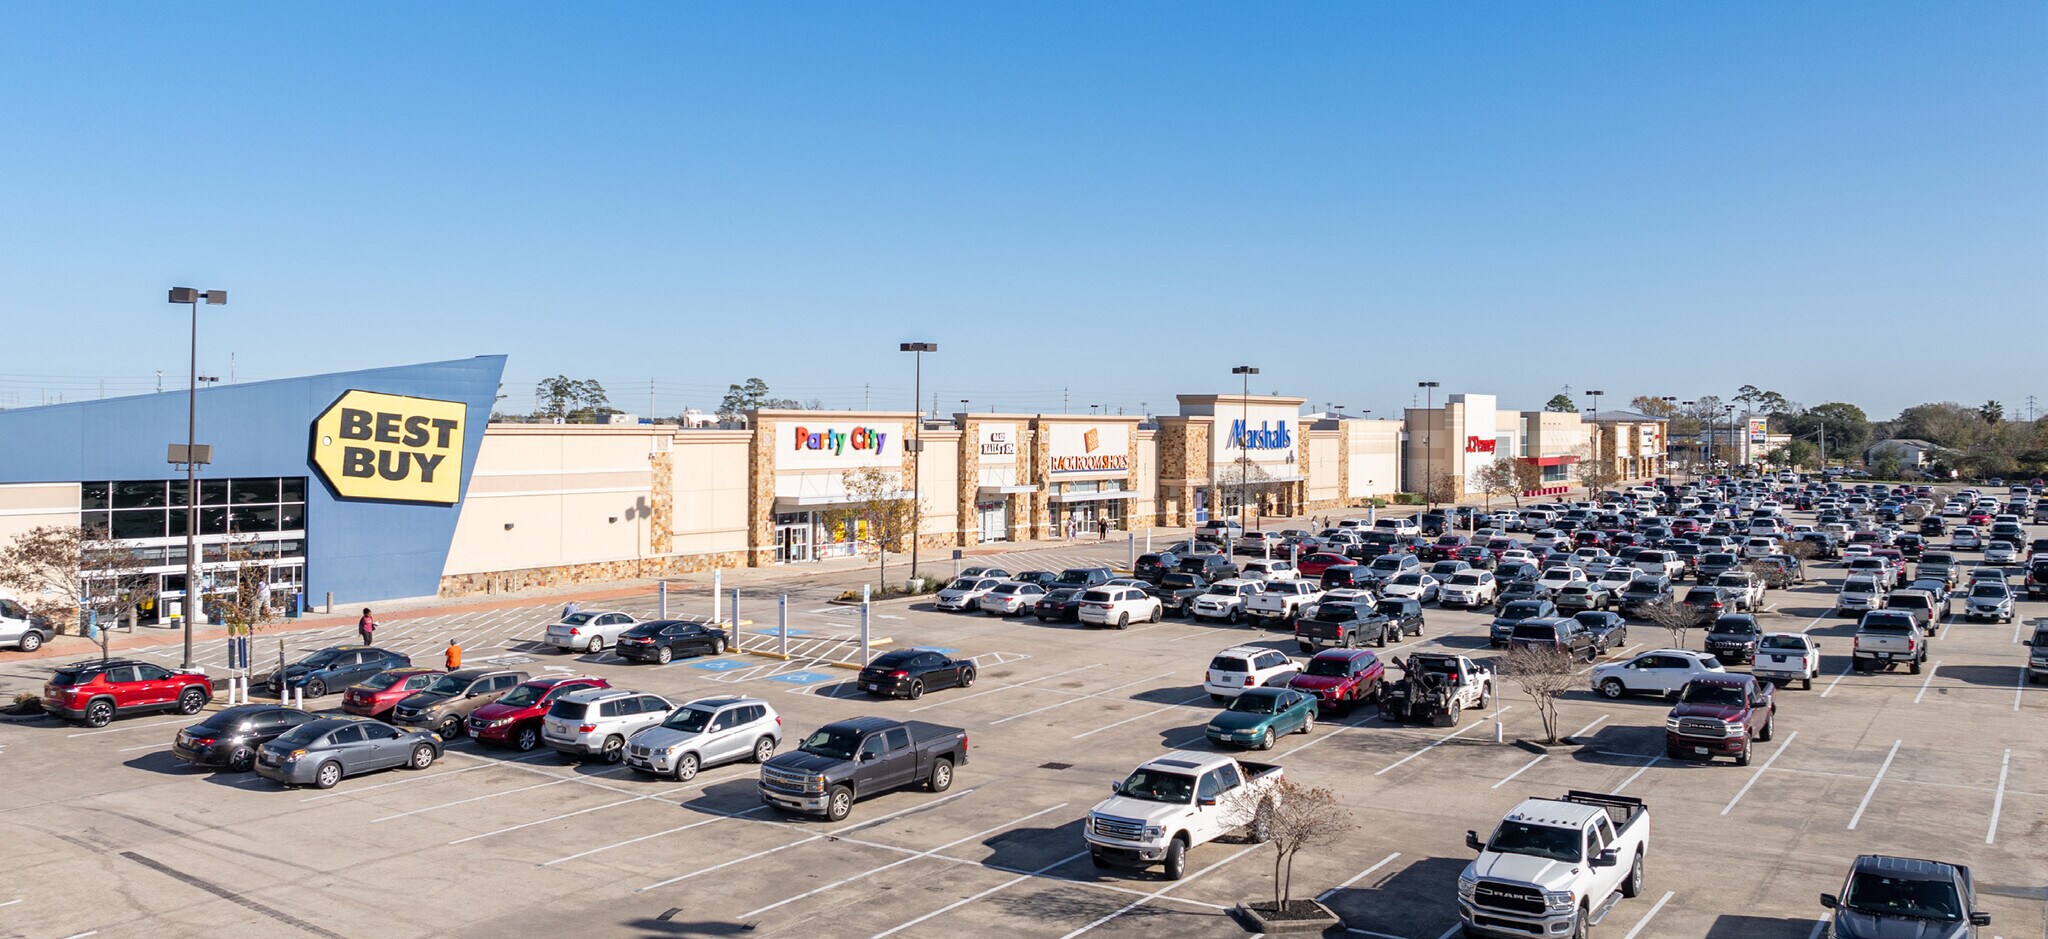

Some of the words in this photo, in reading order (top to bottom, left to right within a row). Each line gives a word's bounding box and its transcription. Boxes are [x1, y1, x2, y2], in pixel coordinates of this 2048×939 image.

[339, 407, 458, 448] BEST
[795, 426, 847, 456] Party
[851, 426, 887, 455] City
[1225, 419, 1291, 450] Marshalls
[342, 446, 446, 483] BUY
[1050, 456, 1075, 471] RACK
[1075, 455, 1102, 470] ROOM
[1102, 454, 1128, 469] SHOES
[1494, 891, 1523, 900] RAM
